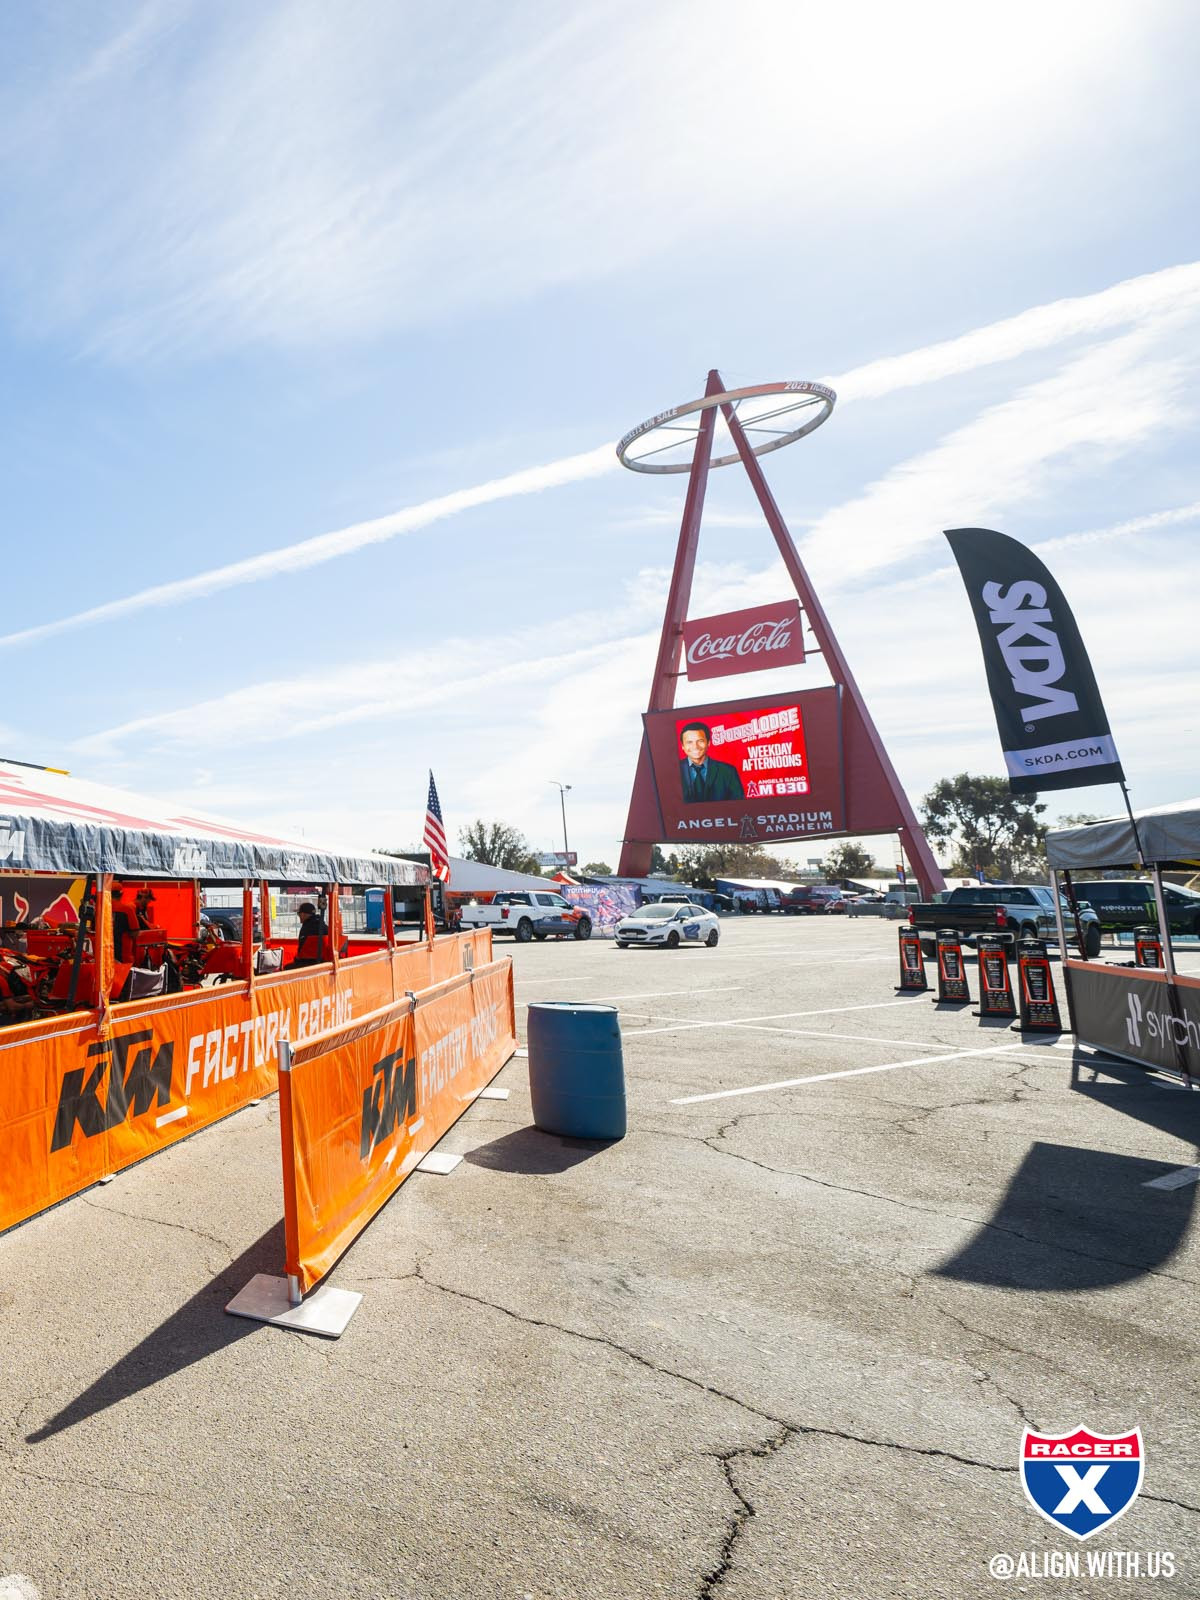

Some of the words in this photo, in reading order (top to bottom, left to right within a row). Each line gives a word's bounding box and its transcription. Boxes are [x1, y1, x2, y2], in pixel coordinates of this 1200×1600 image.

[687, 616, 798, 664] Coca-Cola
[747, 742, 793, 758] WEEKDAY
[1025, 746, 1103, 767] SKDA.COM
[742, 754, 802, 771] AFTERNOONS
[776, 782, 808, 795] 830
[677, 818, 738, 829] ANGEL
[757, 811, 832, 825] STADIUM
[765, 822, 833, 833] ANAHEIM
[173, 842, 207, 872] KTM
[50, 1029, 174, 1153] KTM
[185, 1006, 291, 1096] FACTORY
[360, 1047, 416, 1161] KTM
